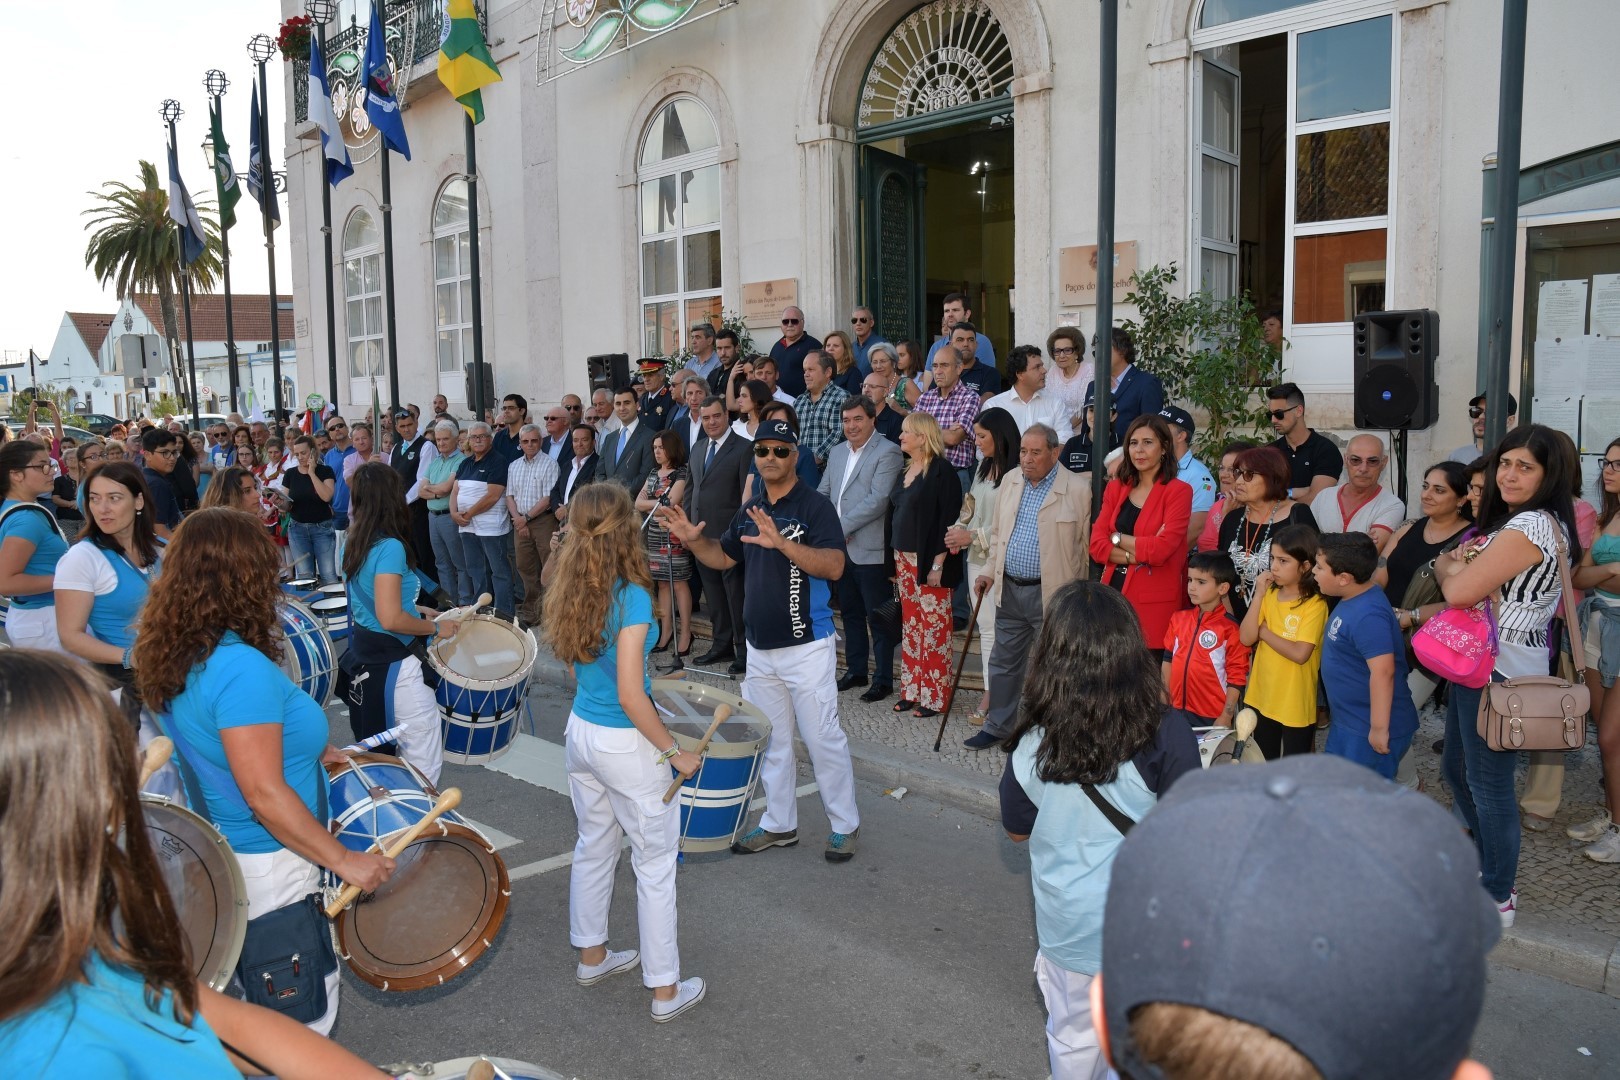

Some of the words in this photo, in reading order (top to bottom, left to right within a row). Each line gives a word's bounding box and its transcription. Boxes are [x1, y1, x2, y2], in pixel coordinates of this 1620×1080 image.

[938, 48, 992, 99] MUNICIPAL
[936, 76, 969, 104] JULHO
[929, 95, 957, 112] 1878
[1065, 283, 1084, 293] Paços
[1087, 282, 1095, 290] do
